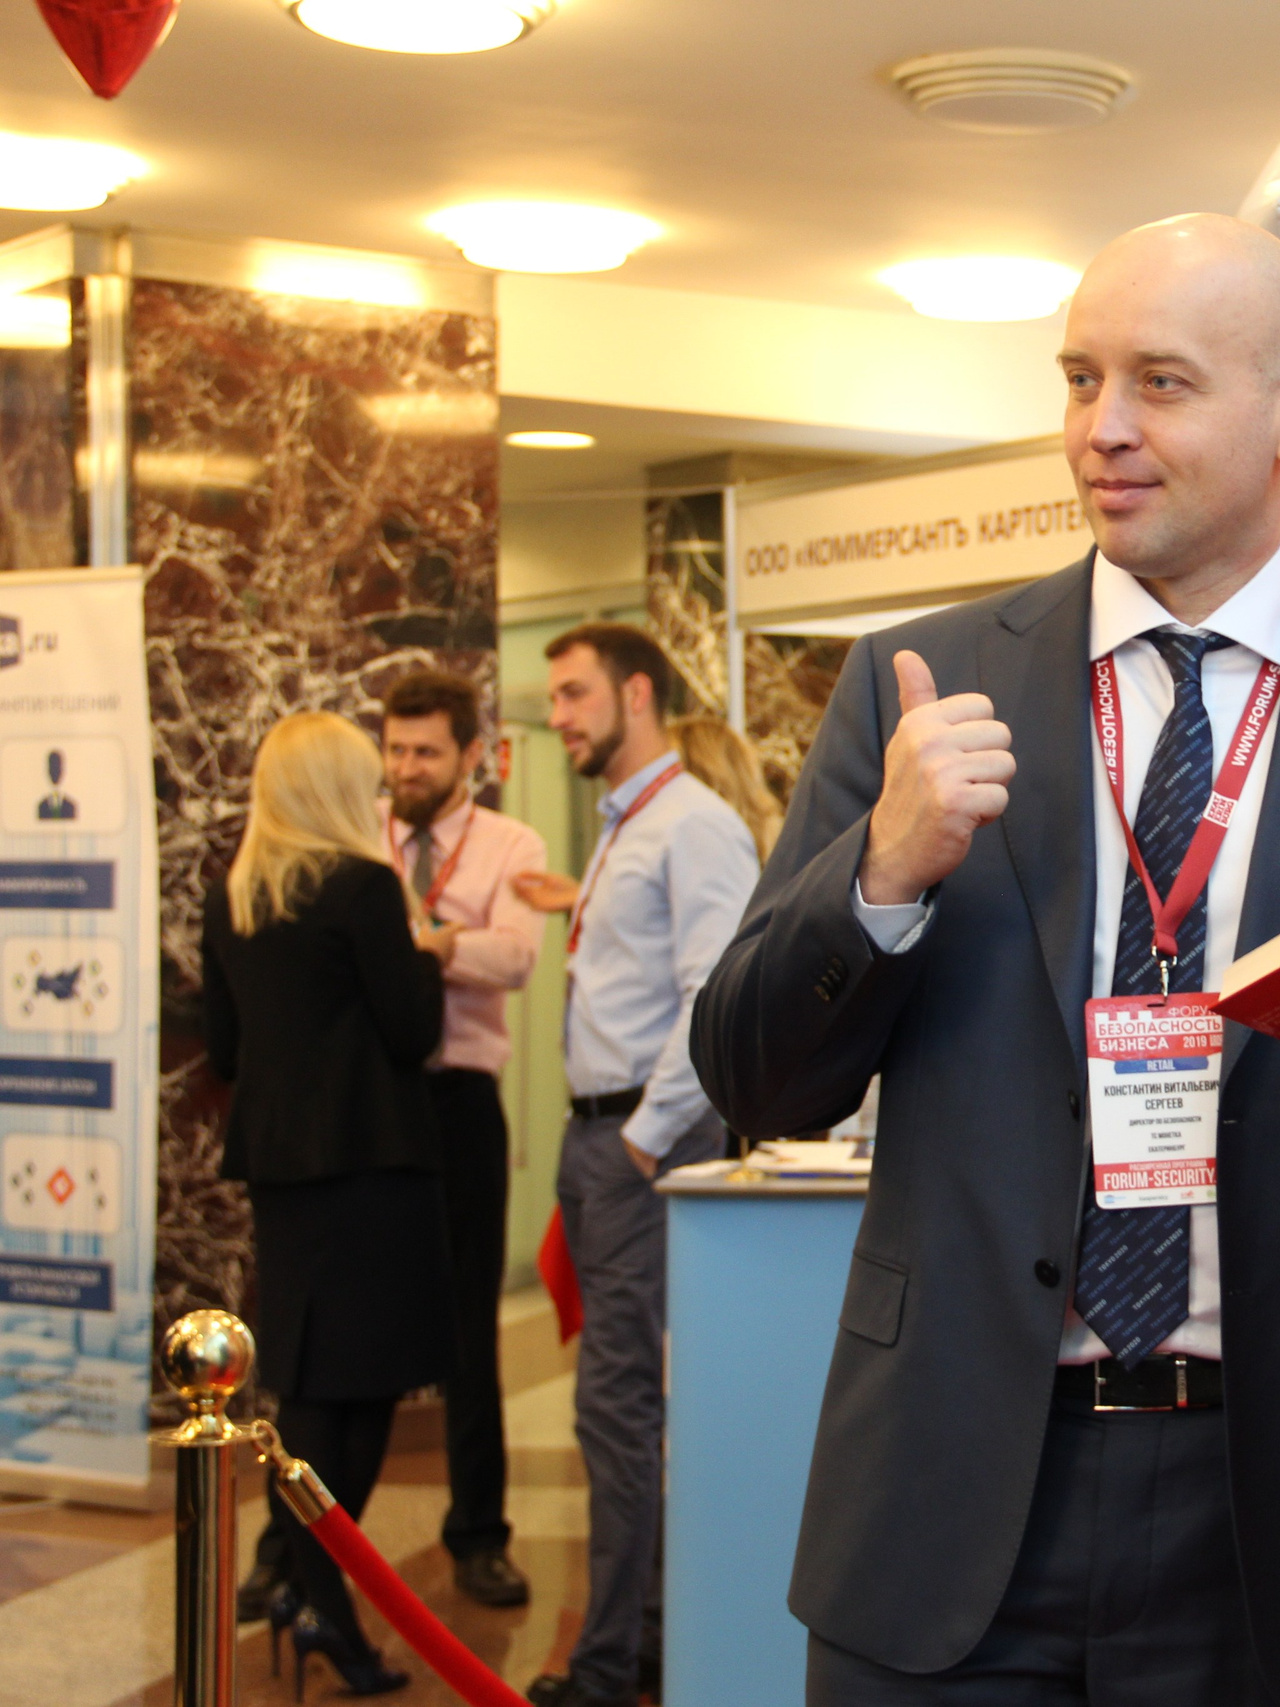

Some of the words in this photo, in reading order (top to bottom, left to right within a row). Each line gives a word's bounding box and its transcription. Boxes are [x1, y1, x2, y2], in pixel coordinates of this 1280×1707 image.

[1098, 1018, 1221, 1037] БЕЗОПАСНОСТЬ
[1099, 1036, 1169, 1052] БИЗНЕСА
[1182, 1034, 1208, 1049] 2019
[1104, 1083, 1162, 1097] КОНСТАНТИН
[1145, 1097, 1184, 1110] СЕРГЕЕВ
